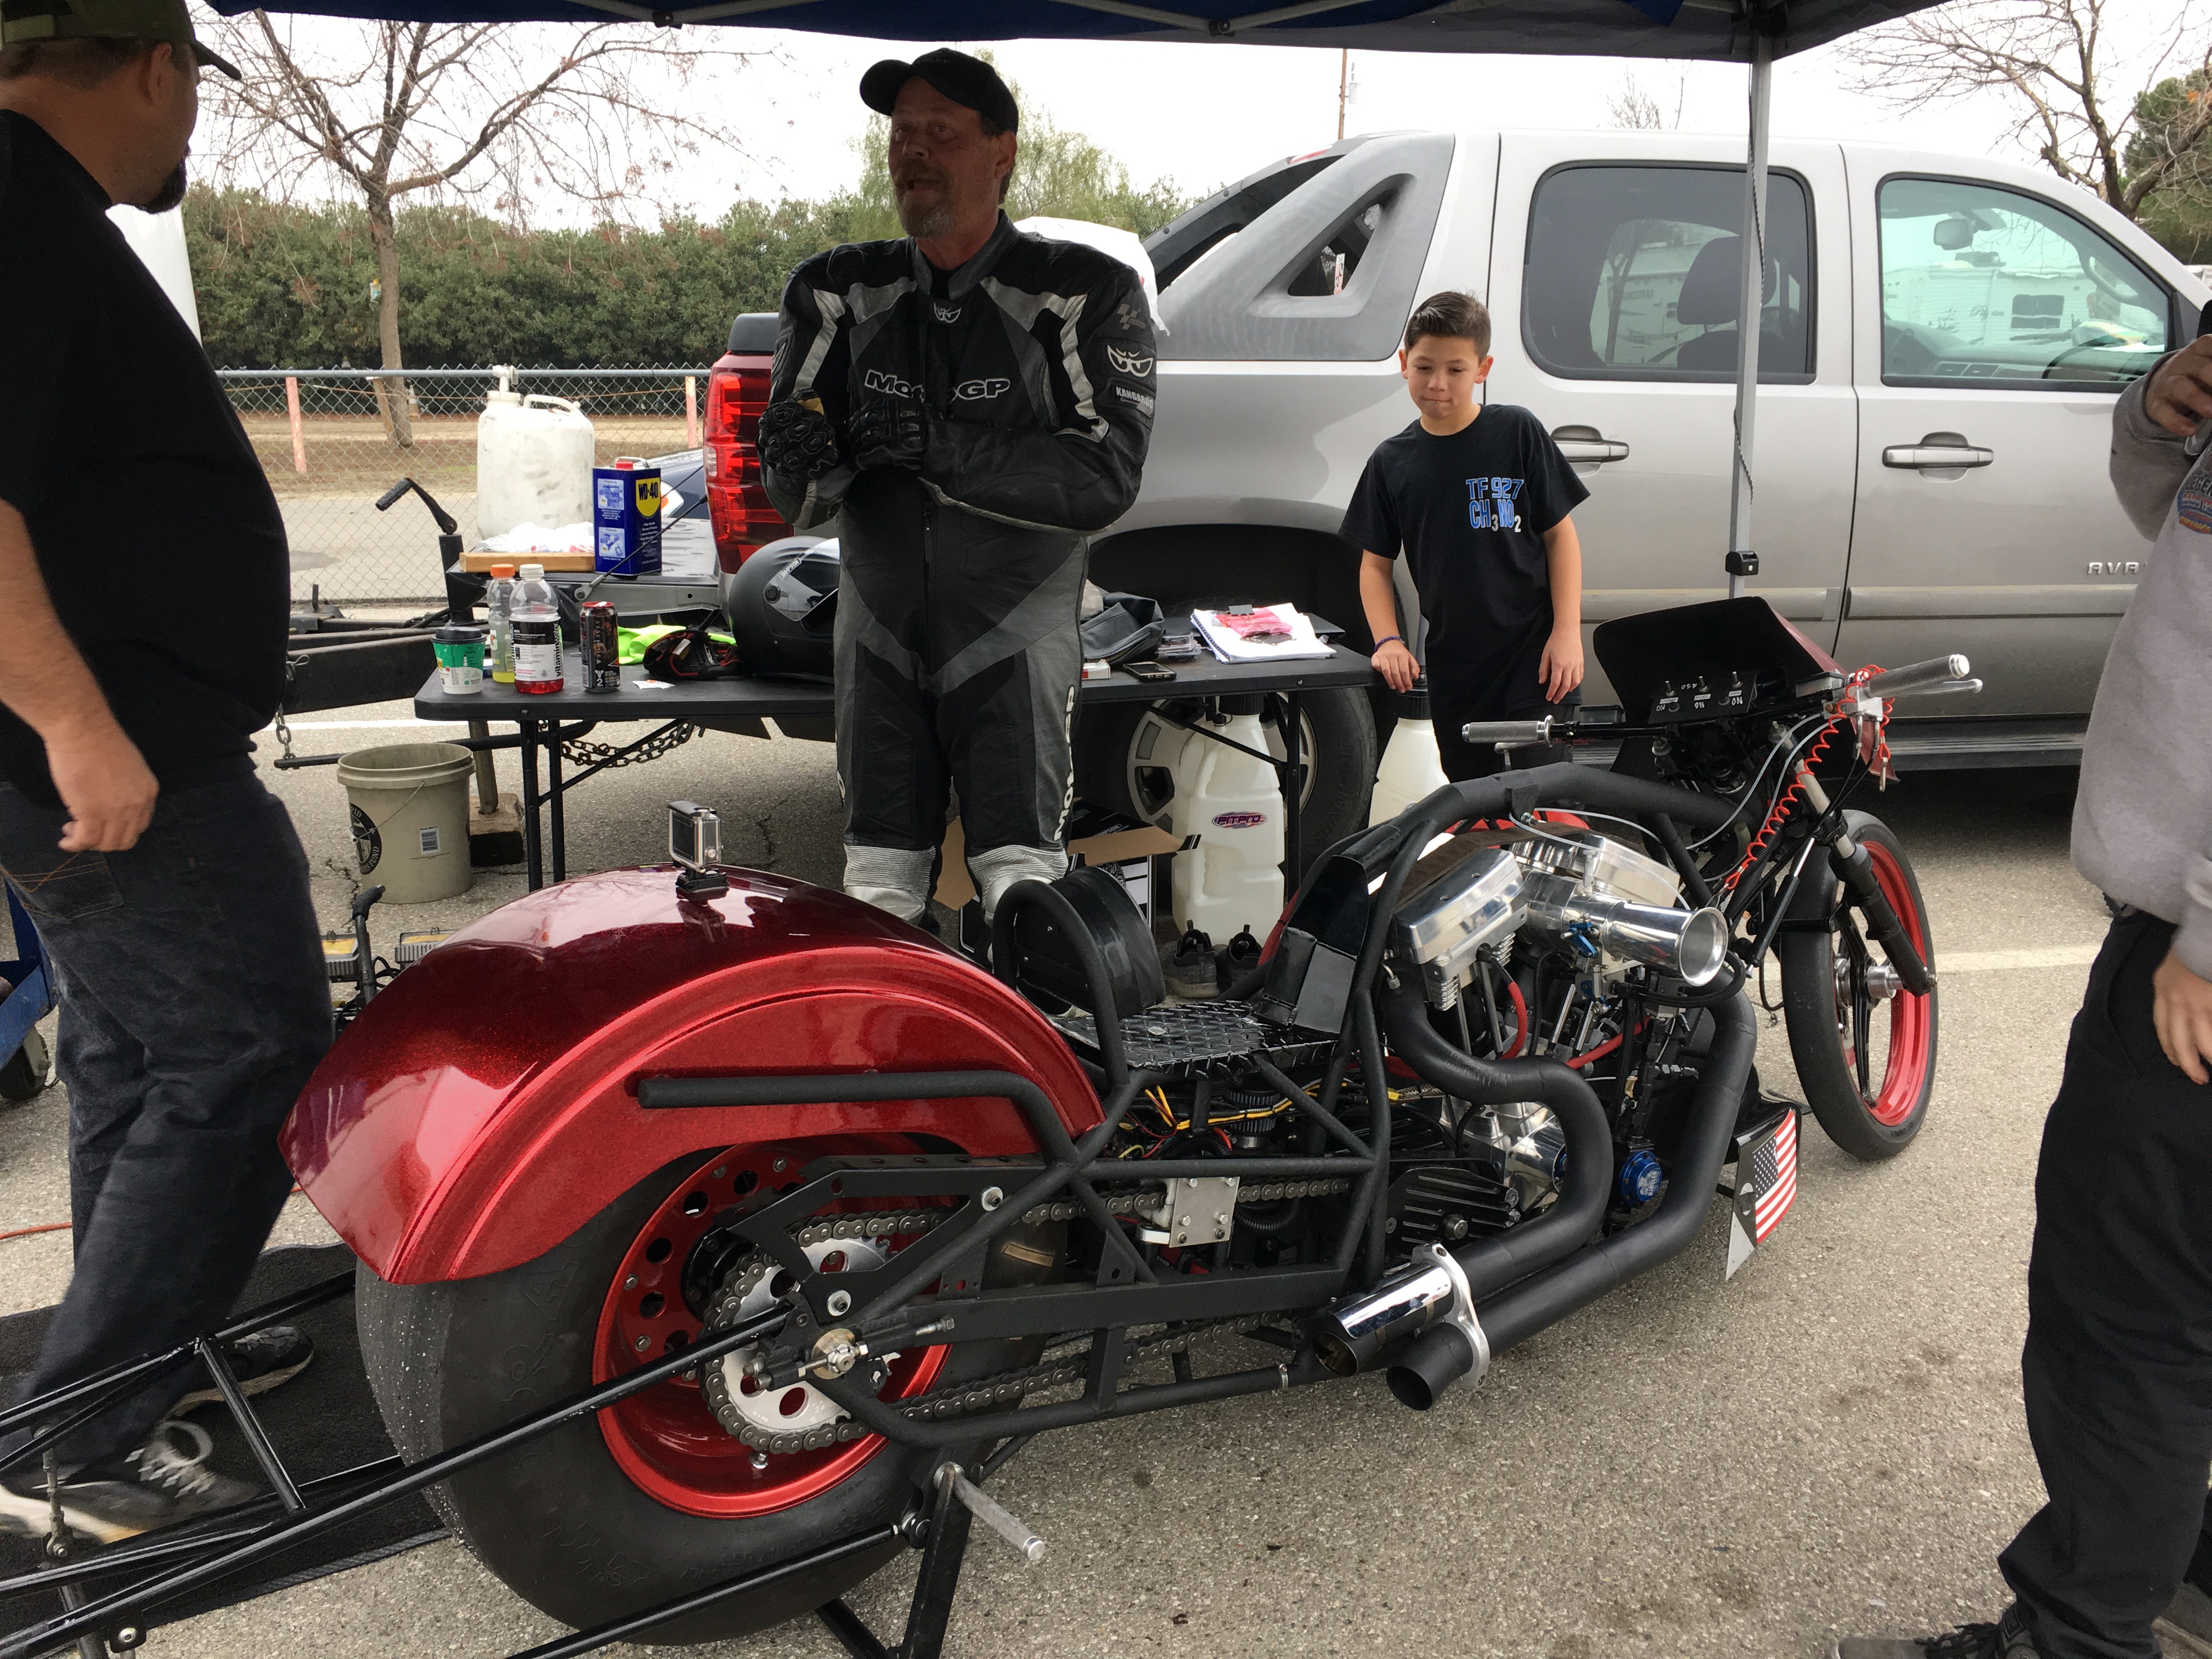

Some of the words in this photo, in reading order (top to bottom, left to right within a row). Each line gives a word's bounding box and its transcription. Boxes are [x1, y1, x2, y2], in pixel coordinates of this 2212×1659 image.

[1116, 386, 1153, 409] KANGAROO
[638, 482, 658, 500] WD-40
[1465, 477, 1488, 499] TF
[1491, 477, 1524, 499] 927
[780, 558, 800, 578] SIMPSON
[2087, 562, 2147, 574] AVA
[1731, 697, 1743, 706] ON
